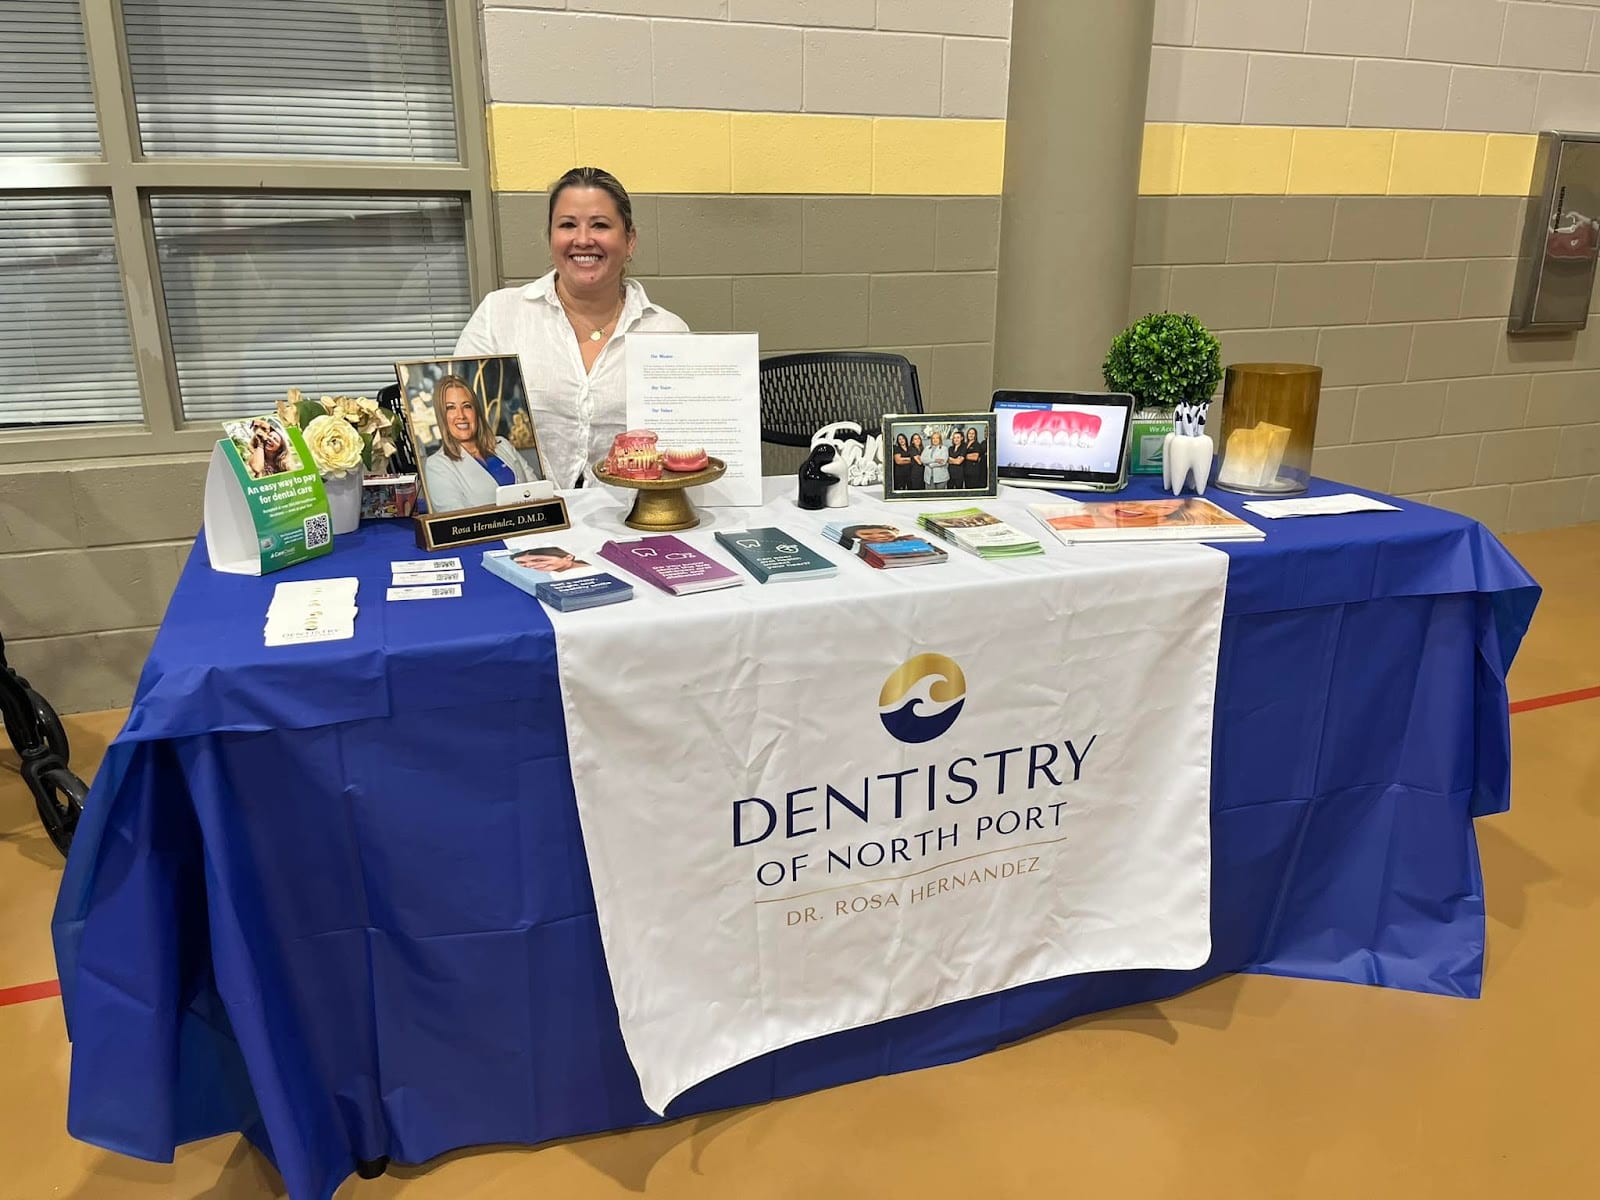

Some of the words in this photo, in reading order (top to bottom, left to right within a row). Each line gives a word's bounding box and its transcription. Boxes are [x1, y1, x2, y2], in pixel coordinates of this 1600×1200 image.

[247, 486, 260, 495] An
[260, 483, 277, 493] easy
[278, 479, 293, 488] way
[294, 476, 302, 484] to
[303, 473, 316, 484] pay
[259, 495, 272, 505] for
[272, 488, 297, 501] dental
[297, 486, 312, 495] care
[451, 525, 471, 536] Rosa
[473, 518, 516, 533] Hernández,
[517, 512, 547, 525] D.M.D.
[733, 735, 1097, 848] DENTISTRY
[756, 854, 809, 887] OF
[829, 823, 958, 874] NORTH
[976, 801, 1067, 841] PORT
[786, 906, 824, 927] DR.
[835, 893, 900, 917] ROSA
[910, 855, 1040, 904] HERNANDEZ
